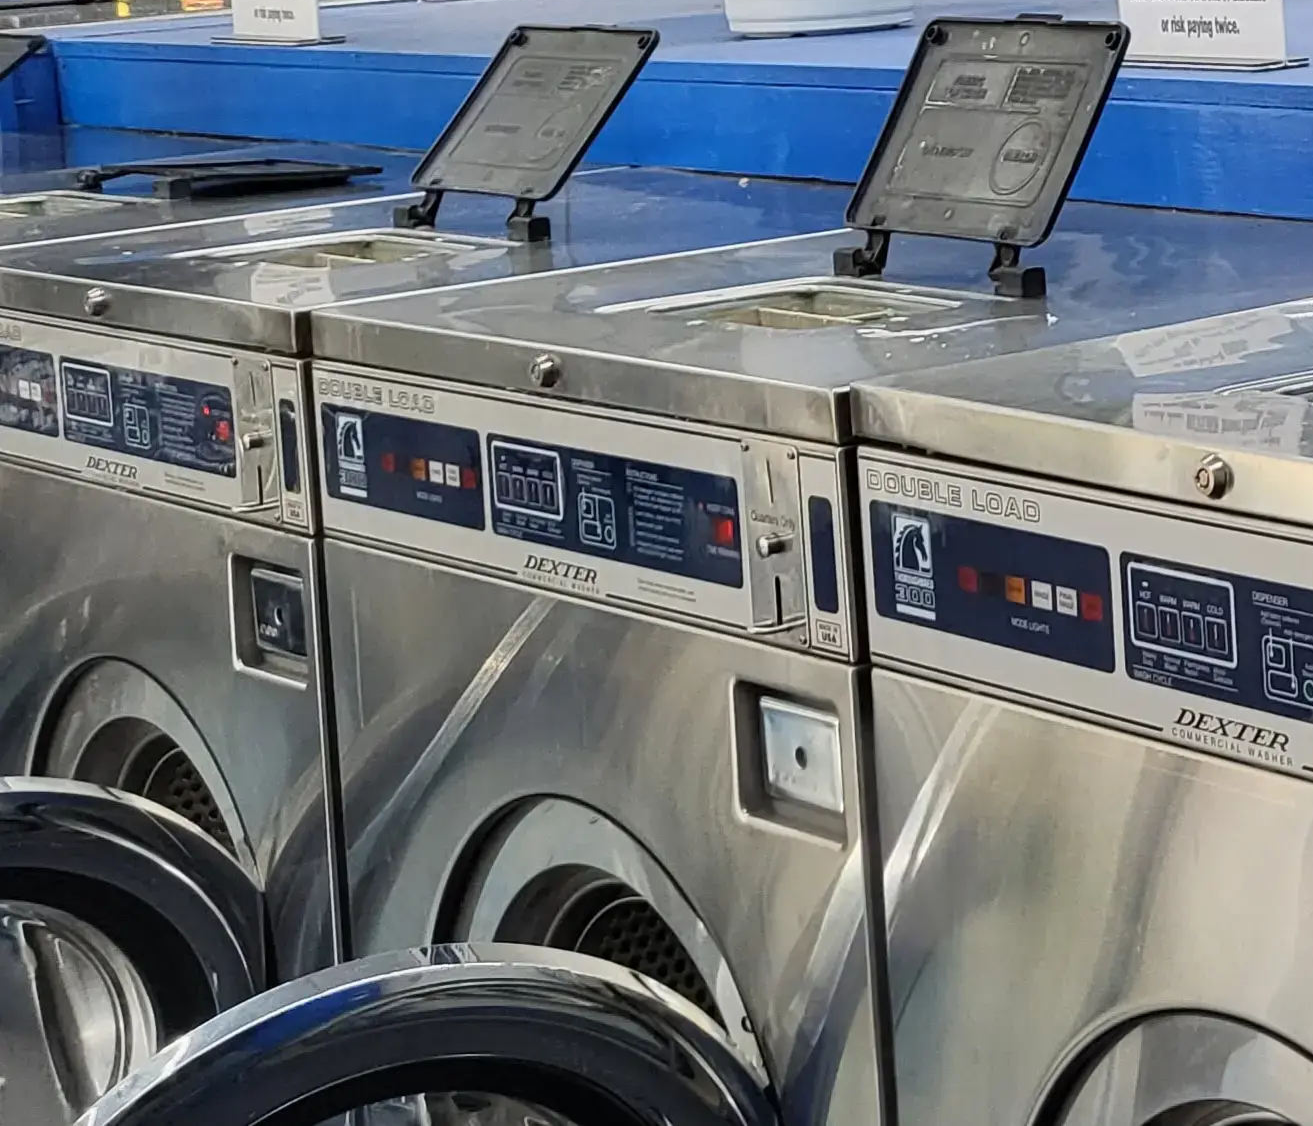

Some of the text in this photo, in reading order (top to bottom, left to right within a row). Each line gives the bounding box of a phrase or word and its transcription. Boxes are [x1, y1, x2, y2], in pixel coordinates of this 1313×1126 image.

[1161, 15, 1240, 38] or risk paying twice.
[318, 377, 435, 414] DOUBLE LOAD
[86, 456, 138, 480] DEXTER
[866, 468, 1041, 523] DOUBLE LOAD
[523, 554, 598, 585] DEXTER
[895, 584, 936, 609] 300
[1174, 707, 1290, 752] DEXTER
[1172, 727, 1293, 767] COMMERCIAL WASHER
